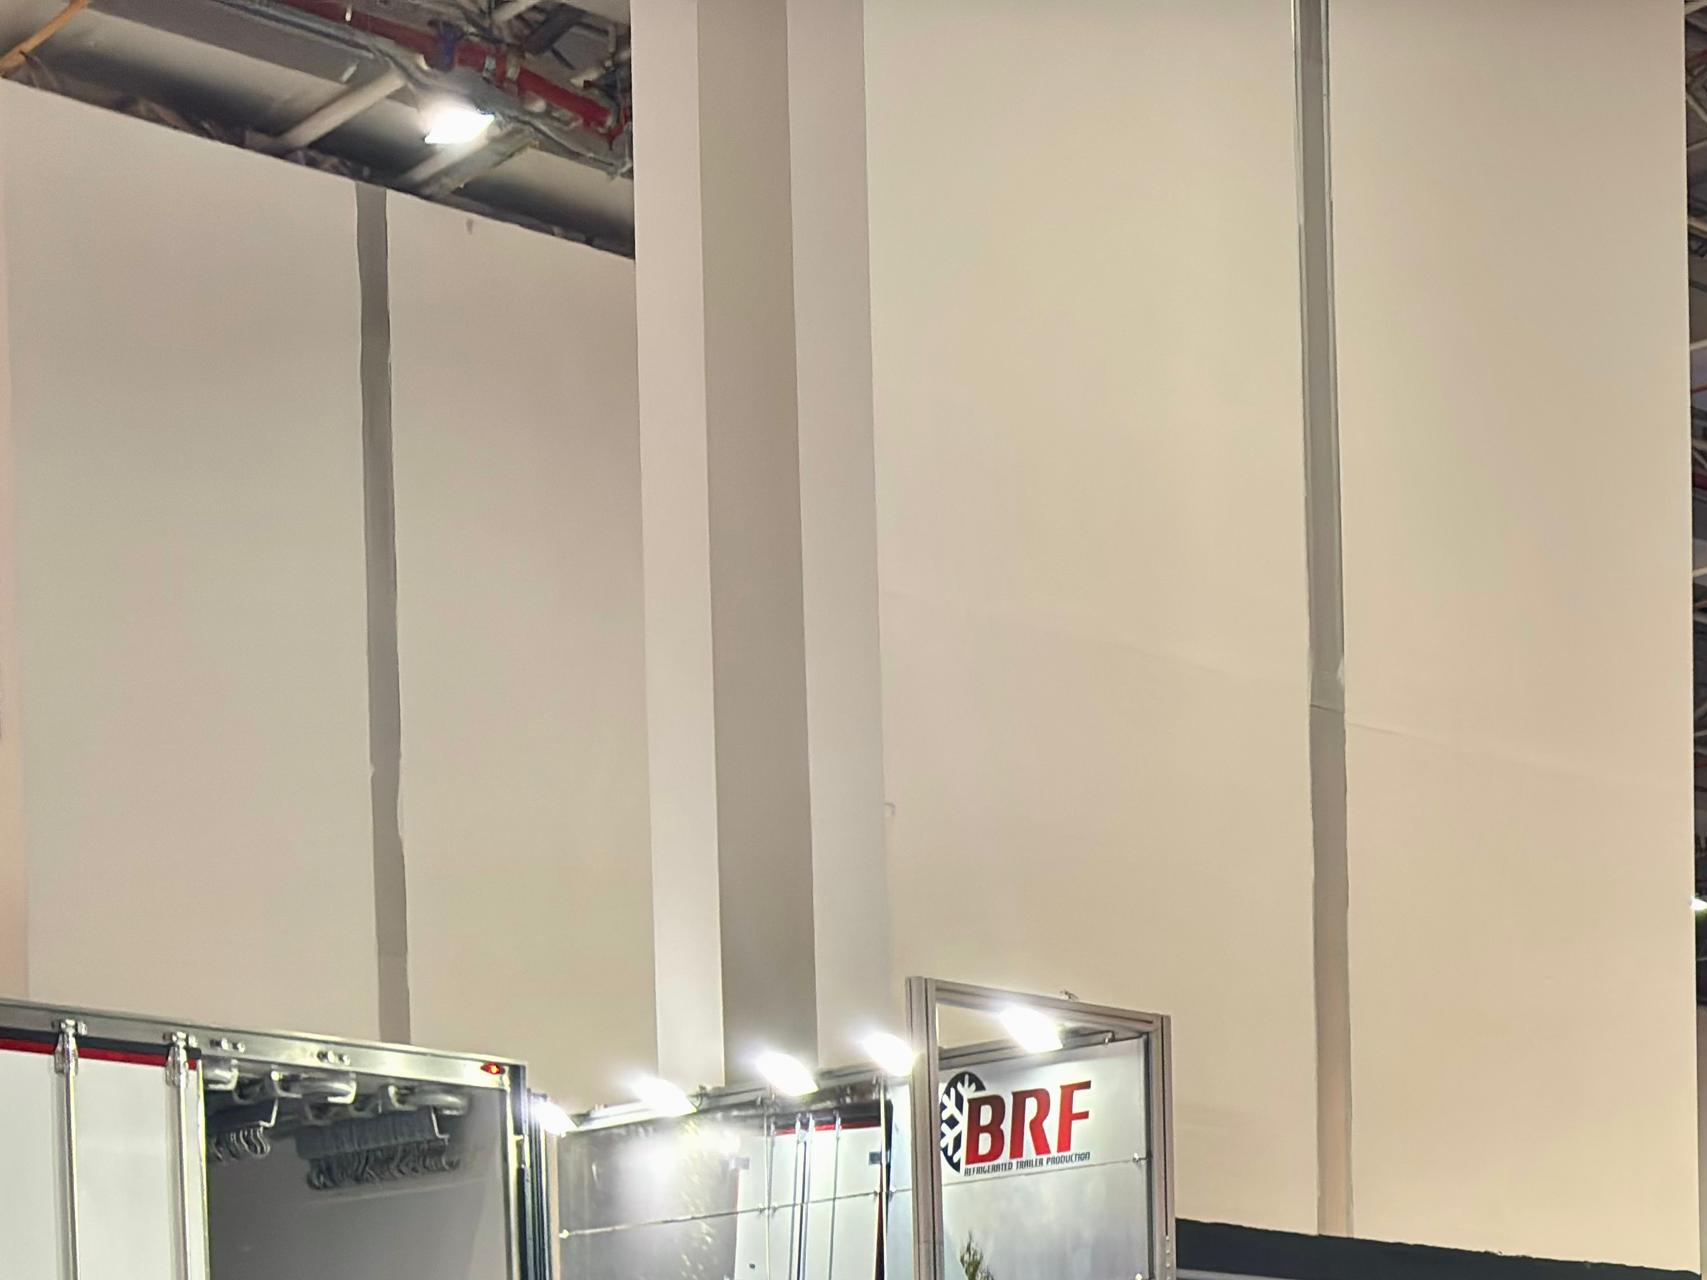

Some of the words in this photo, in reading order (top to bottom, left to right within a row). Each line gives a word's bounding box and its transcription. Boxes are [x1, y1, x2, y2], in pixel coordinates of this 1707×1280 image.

[964, 1080, 1092, 1166] BRF
[964, 1162, 1013, 1176] REFRIGERATED
[1015, 1157, 1044, 1171] TRAILER
[1045, 1151, 1091, 1166] PRODUCTION
